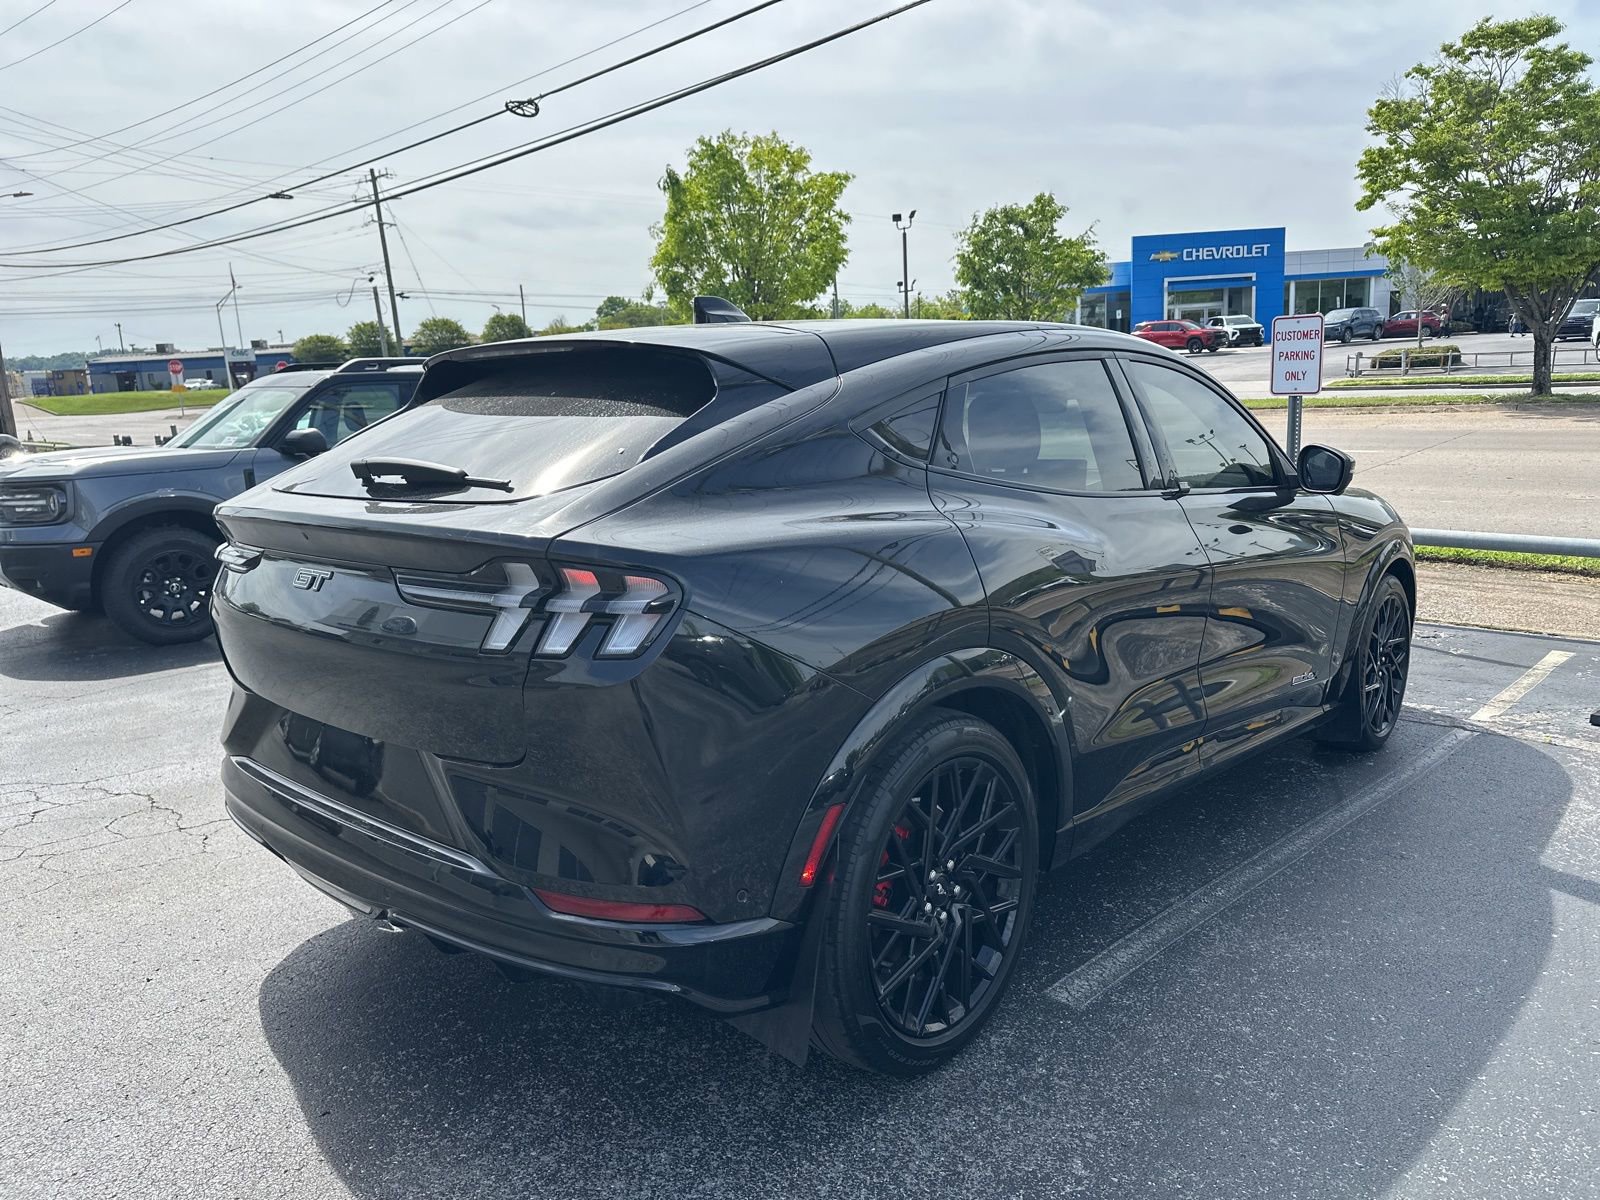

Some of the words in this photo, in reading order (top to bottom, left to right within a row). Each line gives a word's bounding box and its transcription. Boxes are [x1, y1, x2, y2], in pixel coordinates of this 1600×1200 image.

[1183, 244, 1270, 261] CHEVROLET
[1275, 329, 1320, 341] CUSTOMER
[1278, 350, 1315, 361] PARKING
[1285, 371, 1307, 381] ONLY
[293, 567, 334, 592] GT
